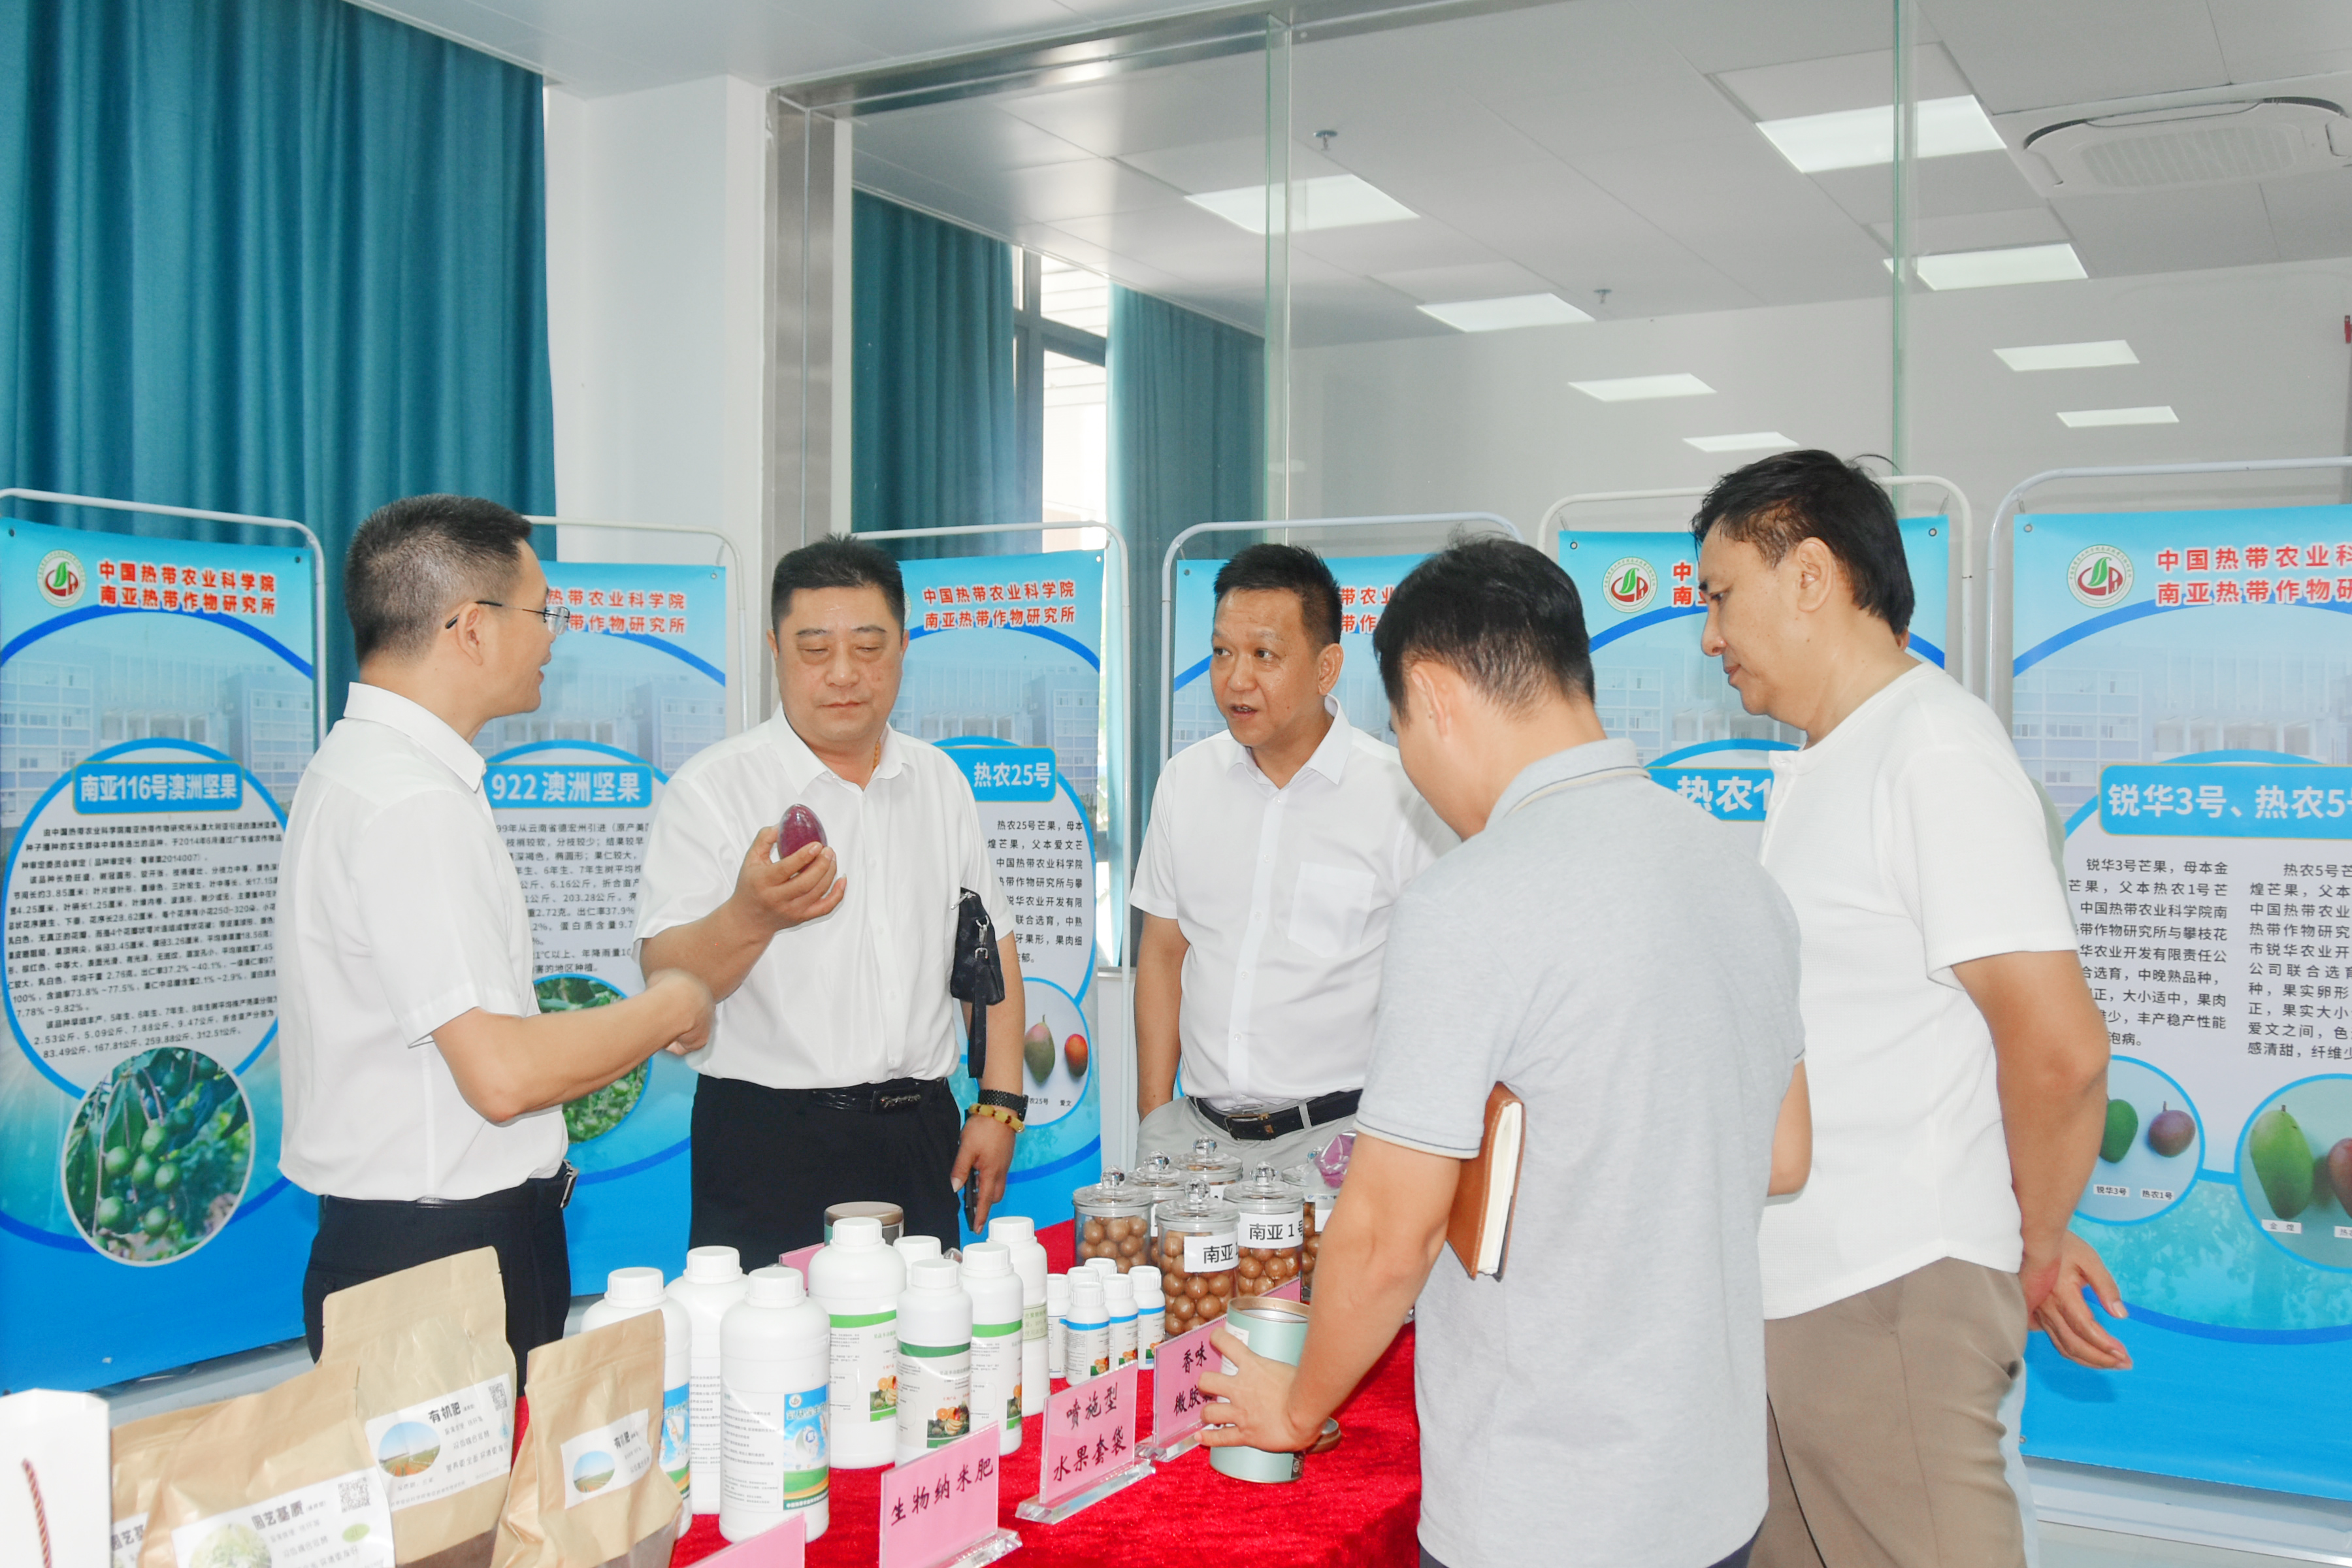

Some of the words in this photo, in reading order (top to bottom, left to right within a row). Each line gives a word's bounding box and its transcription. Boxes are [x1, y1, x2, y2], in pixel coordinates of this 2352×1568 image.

[2157, 544, 2352, 572] 中国热带农业科
[99, 561, 275, 592] 中国热带农业科学院
[100, 586, 275, 615] 南亚热带作物研究所
[547, 589, 685, 610] 热带农业科学院
[924, 581, 1075, 604] 中国热带农业科学院
[2157, 579, 2352, 604] 南亚热带作物研
[569, 614, 685, 633] 带作物研究所
[925, 606, 1075, 629] 南亚热带作物研究所
[974, 762, 1051, 788] 热农25号
[81, 774, 237, 802] 南亚116号澳洲坚果
[2108, 784, 2352, 819] 锐华3号、热农5
[996, 858, 1083, 870] 中国热带农业科学院
[2087, 858, 2228, 875] 锐华3号芒果，母本金
[2080, 902, 2227, 919] 中国热带农业科学院南
[2251, 902, 2349, 918] 中国热带农业
[2076, 923, 2227, 941] 带作物研究所与攀枝花
[2249, 922, 2349, 938] 热带作物研究
[2249, 943, 2349, 959] 市锐华农业开
[2097, 1186, 2127, 1196] 锐华3号
[2142, 1190, 2173, 1200] 热农1号
[1183, 1341, 1207, 1373] 香味
[428, 1401, 461, 1424] 有机肥
[1054, 1426, 1126, 1482] 水果套袋
[890, 1458, 993, 1526] 生物纳米肥
[252, 1500, 304, 1530] 园艺基质
